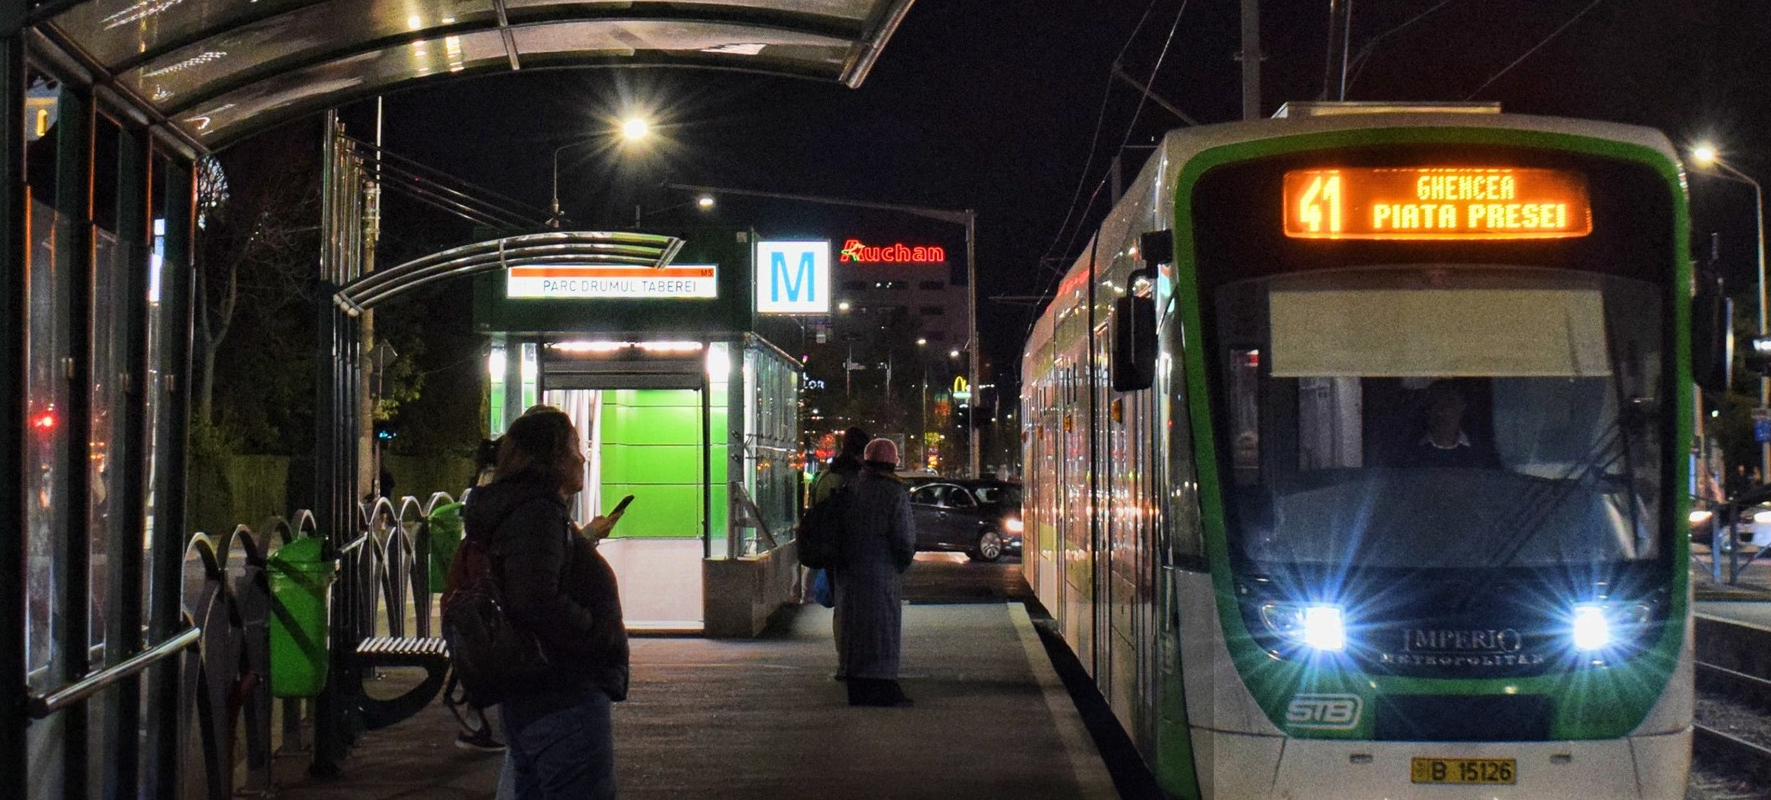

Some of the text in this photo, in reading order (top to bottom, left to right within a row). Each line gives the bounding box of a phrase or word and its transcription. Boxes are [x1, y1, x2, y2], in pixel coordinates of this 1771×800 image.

[1416, 175, 1515, 200] GHENCEA
[1299, 175, 1341, 232] 41
[1373, 203, 1567, 229] PIATA PRESEI
[841, 239, 944, 262] Auchan
[543, 279, 697, 293] PARC DRUMUL TABEREI
[771, 251, 815, 302] M
[1401, 628, 1522, 653] IMPERIO
[1286, 699, 1355, 723] STB
[1431, 760, 1512, 782] B 15126
